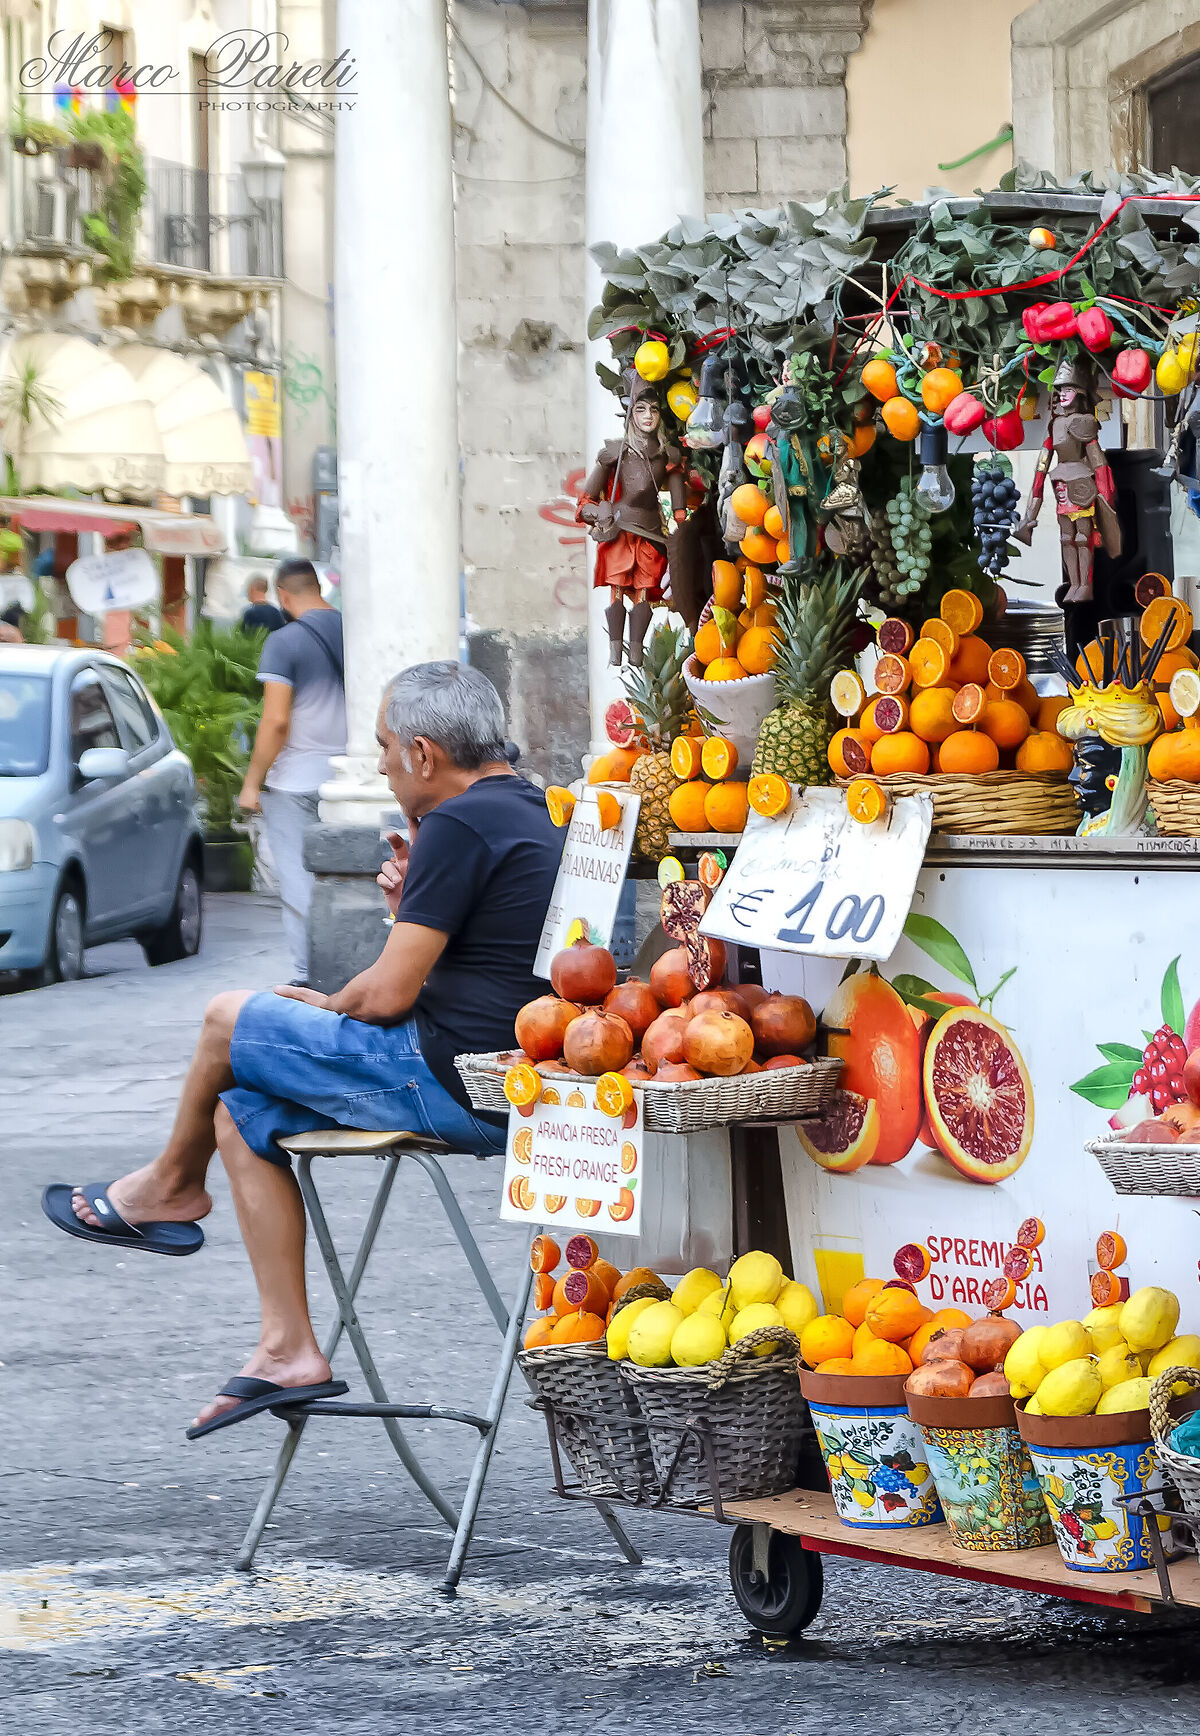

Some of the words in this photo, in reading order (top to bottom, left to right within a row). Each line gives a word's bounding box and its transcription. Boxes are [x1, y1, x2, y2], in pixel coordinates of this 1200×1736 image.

[729, 889, 775, 928] €
[537, 1121, 578, 1142] ARANCIA
[580, 1126, 618, 1147] FRESCA
[534, 1154, 570, 1178] FRESH
[573, 1159, 619, 1183] ORANGE
[929, 1273, 1049, 1311] D'ARACIA
